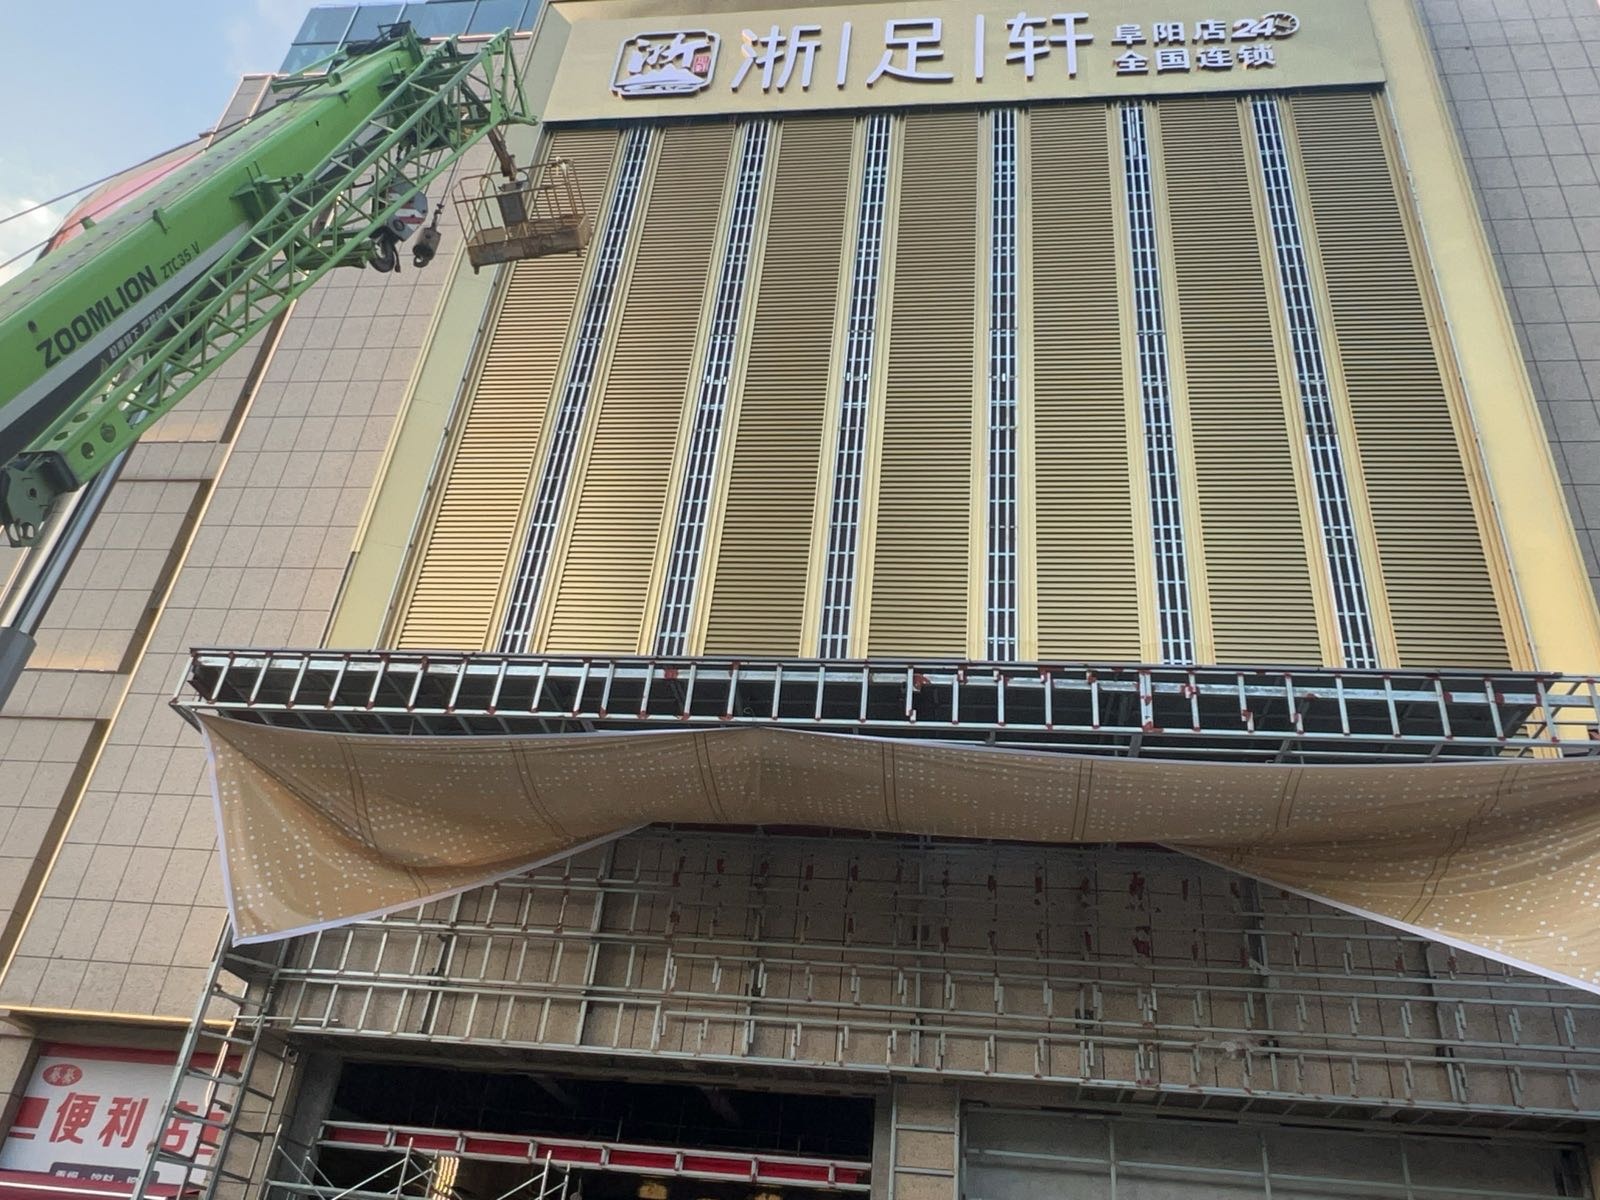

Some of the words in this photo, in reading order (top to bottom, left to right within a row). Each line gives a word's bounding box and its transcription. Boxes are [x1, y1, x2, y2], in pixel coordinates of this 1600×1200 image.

[1114, 43, 1276, 76] 全国连锁
[36, 265, 158, 369] ZOOMLION
